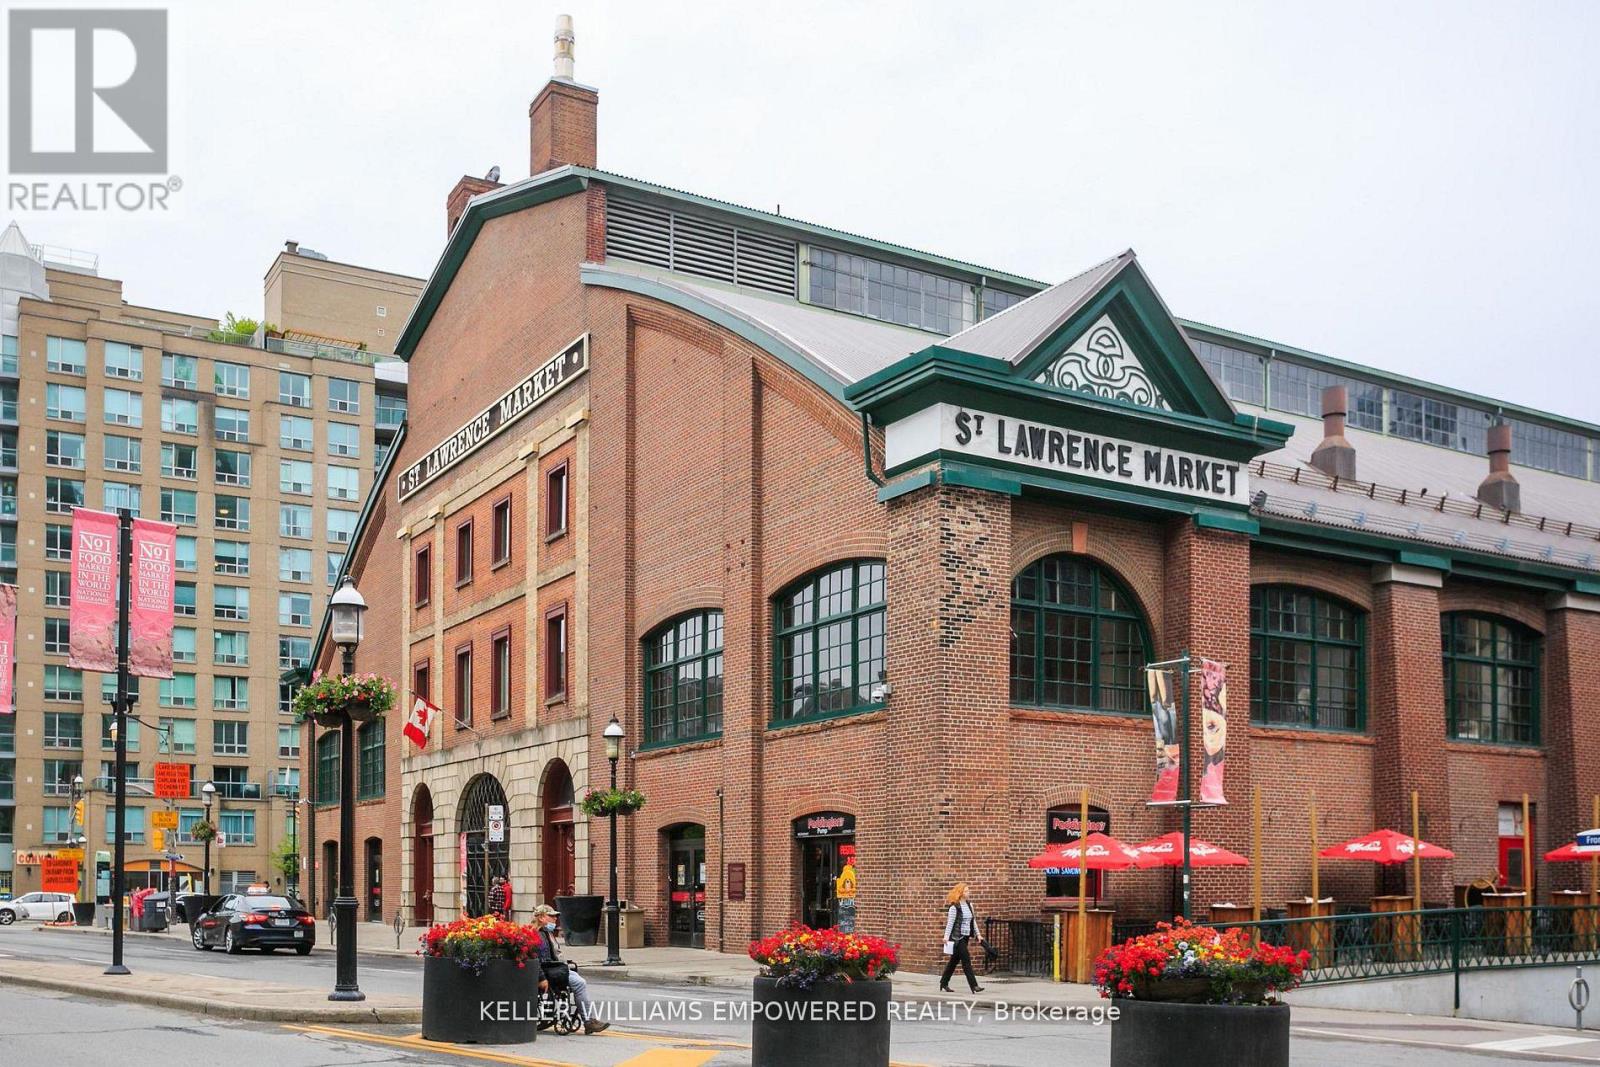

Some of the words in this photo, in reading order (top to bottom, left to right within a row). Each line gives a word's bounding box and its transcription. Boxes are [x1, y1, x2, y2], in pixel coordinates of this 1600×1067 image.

[426, 411, 490, 478] LAWRENCE
[499, 354, 566, 425] MARKET
[997, 419, 1133, 477] LAWRENCE
[1144, 450, 1240, 496] MARKET
[79, 552, 112, 565] FOOD
[78, 562, 111, 573] MARKET
[139, 561, 171, 573] FOOD
[78, 571, 89, 579] IN
[92, 573, 110, 583] THE
[139, 571, 170, 581] MARKET
[78, 579, 111, 591] WORLD
[139, 580, 149, 588] IN
[152, 582, 170, 591] THE
[138, 587, 170, 598] WORLD
